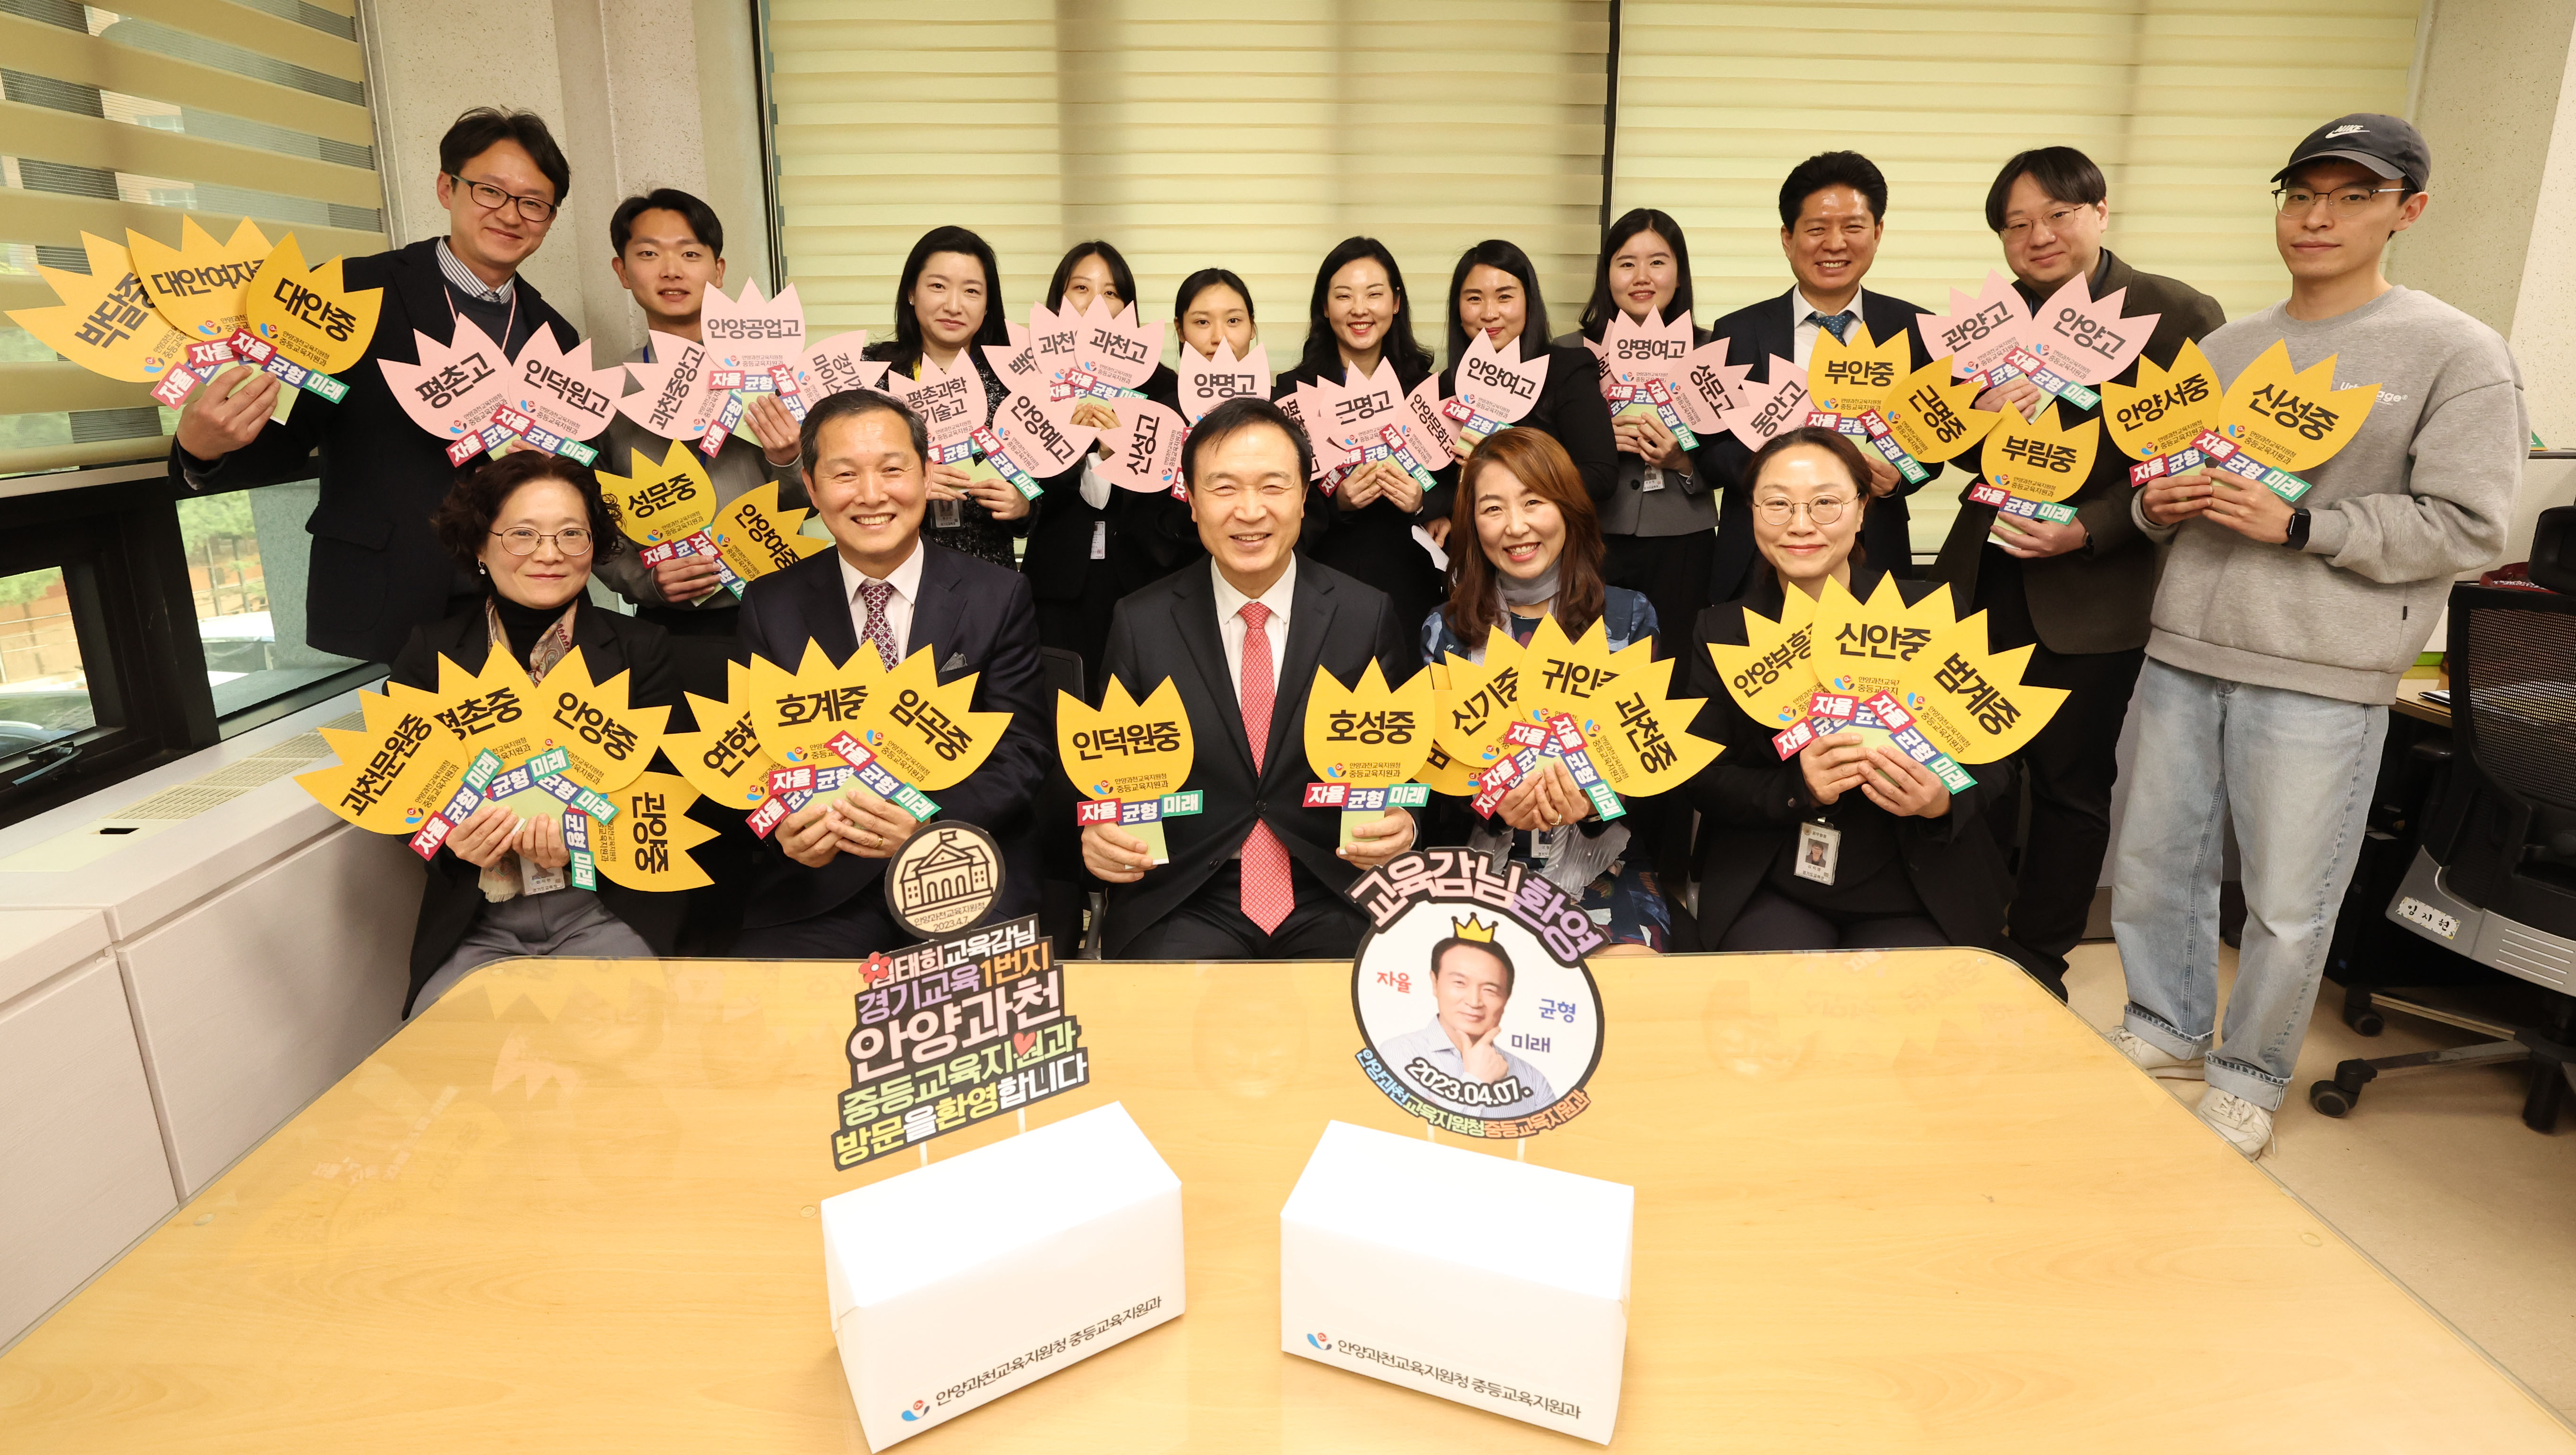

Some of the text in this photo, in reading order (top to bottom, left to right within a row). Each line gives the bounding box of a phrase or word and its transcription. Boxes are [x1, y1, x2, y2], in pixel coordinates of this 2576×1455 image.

[2335, 125, 2363, 133] NIKE
[151, 259, 265, 297] 대안여자
[274, 277, 356, 342] 대안중
[1942, 300, 2014, 353] 관양고
[282, 330, 330, 359] 안양과천교육지원청
[707, 319, 801, 339] 안양공업고
[1089, 328, 1148, 365] 과천고
[2053, 307, 2126, 360] 안양고
[231, 332, 345, 400] 자율 균형 미래
[279, 337, 326, 367] 중등교육지원과
[1617, 339, 1686, 360] 양명여고
[415, 352, 496, 409] 평촌고
[523, 359, 610, 419] 인덕원고
[649, 346, 706, 430] 과천중앙고
[712, 373, 741, 387] 자율
[771, 367, 796, 394] 자율
[1068, 370, 1094, 387] 자율
[1194, 373, 1257, 398] 양명고
[1467, 357, 1536, 400] 안양여고
[1690, 364, 1735, 419] 성문고
[1824, 360, 1894, 387] 부안중
[2008, 350, 2097, 407] 자율 균형 미래
[906, 377, 967, 410] 평촌과학
[1609, 386, 1633, 398] 자율
[1648, 381, 1669, 403] 자율
[1750, 380, 1808, 437] 동안고
[2116, 373, 2210, 432] 안양서중
[537, 411, 578, 435] 중등교육지원과
[539, 405, 581, 429] 안양과천교육지원청
[702, 425, 726, 453] 자율
[723, 398, 743, 429] 균형
[921, 398, 967, 424] 기술고
[1445, 402, 1472, 421] 자율
[1467, 416, 1495, 435] 균형
[1658, 405, 1679, 426] 균형
[1808, 414, 1837, 427] 자율
[1908, 385, 1967, 444] 근명중
[2248, 383, 2340, 441] 신성중
[449, 434, 482, 462] 자율
[496, 408, 594, 464] 자율 균형 미래
[1010, 396, 1075, 465] 안양예고
[1127, 414, 1160, 476] 신성고
[1675, 426, 1697, 450] 미래
[1862, 412, 1926, 480] 자율 균형 미래
[2249, 430, 2297, 458] 안양과천교육지원청
[943, 443, 969, 462] 균형
[974, 428, 1040, 497] 자율 균형 미래
[1382, 426, 1434, 488] 자율 균형 미래
[2002, 435, 2077, 473] 부림중
[2133, 448, 2199, 482] 자율 균형
[2196, 431, 2302, 497] 자율 균형 미래
[2244, 437, 2292, 465] 중등교육지원과
[628, 473, 696, 518] 성문중
[1974, 486, 2072, 522] 자율 균형 미래
[643, 543, 674, 565] 자율
[1734, 622, 1813, 698] 안양부흥
[1835, 623, 1932, 662] 신안중
[776, 685, 869, 728] 호계중
[1812, 696, 1853, 717] 자율
[1933, 652, 2022, 736] 범계중
[553, 692, 638, 761] 안양중
[889, 689, 973, 762] 임곡중
[1072, 721, 1181, 761] 인덕원중
[1327, 710, 1416, 745] 호성중
[1508, 725, 1546, 747] 자율
[1552, 716, 1583, 750] 자율
[1615, 691, 1678, 774] 과천중
[1778, 722, 1813, 755] 자율
[1870, 694, 1910, 729] 자율
[1895, 728, 1937, 763] 균형
[1930, 755, 1972, 790] 미래
[1921, 710, 1965, 754] 중등교육지원과
[1928, 705, 1971, 748] 안양과천교육지원청
[703, 710, 762, 779] 연현
[340, 713, 432, 817] 과천문원중
[414, 760, 451, 803] 안양과천교육지원청
[492, 749, 566, 797] 균형 미래
[773, 768, 811, 791] 자율
[831, 735, 871, 767] 자율
[858, 764, 899, 796] 균형
[894, 785, 935, 819] 미래
[1115, 773, 1167, 785] 안양과천교육지원청
[1349, 770, 1401, 778] 중등교육지원과
[1482, 759, 1516, 792] 자율
[1565, 753, 1598, 785] 균형
[413, 751, 501, 855] 자율 균형 미래
[422, 764, 460, 808] 중등교육지원과
[1116, 780, 1169, 793] 중등교육지원과
[1308, 785, 1427, 809] 자율 균형 미래
[1591, 782, 1622, 818] 미래
[576, 790, 615, 821] 미래
[751, 798, 786, 833] 자율
[1082, 793, 1199, 823] 자율 균형 미래
[565, 814, 586, 849] 균형
[632, 792, 668, 874] 관양중
[573, 852, 594, 887] 미래
[914, 902, 985, 926] 안양과천교육지원청
[1377, 971, 1412, 994] 자율
[850, 970, 1061, 1083] 안양과천
[1539, 998, 1576, 1024] 균형
[1511, 1034, 1551, 1053] 미래
[843, 1020, 1076, 1127] 중등교육지원과
[936, 1296, 1162, 1406] 안양과천교육지원청 중등교육지원과
[1337, 1339, 1582, 1420] 안양과천교육지원청 중등교육지원과
